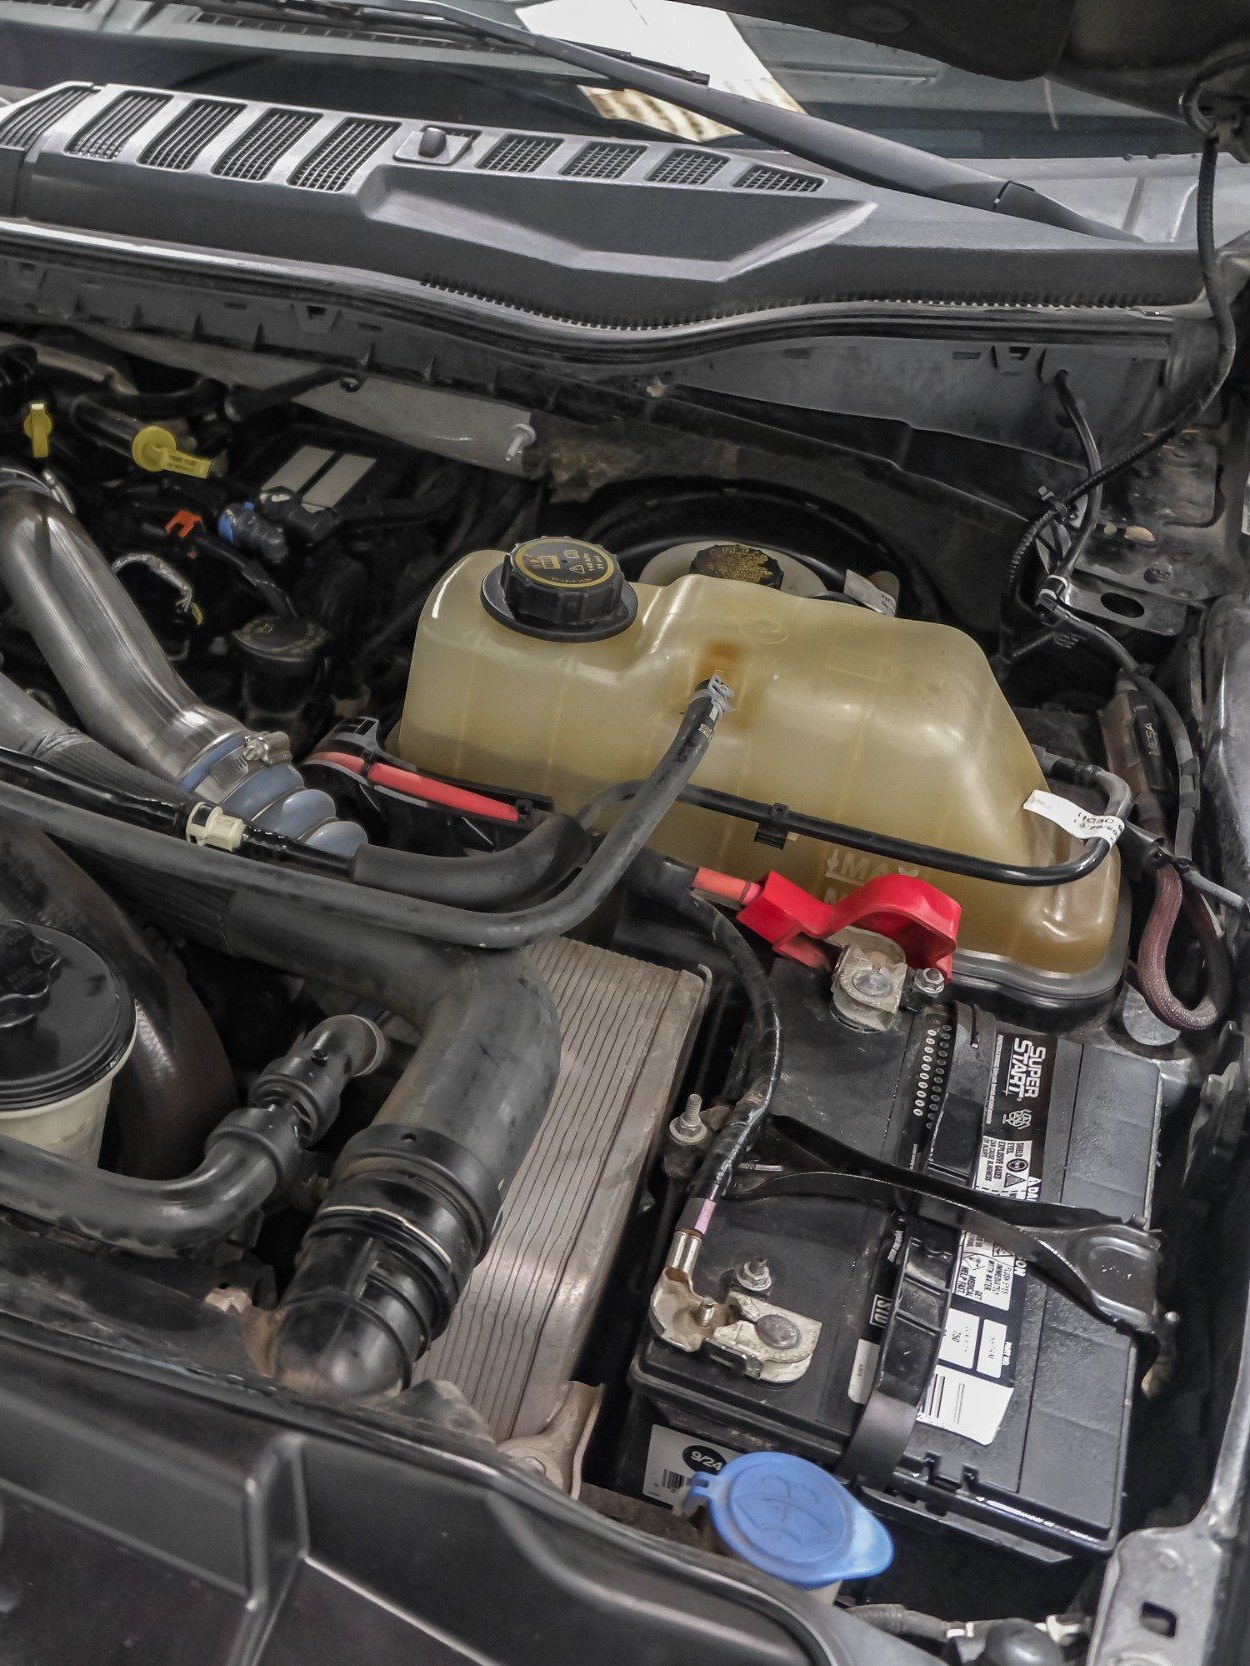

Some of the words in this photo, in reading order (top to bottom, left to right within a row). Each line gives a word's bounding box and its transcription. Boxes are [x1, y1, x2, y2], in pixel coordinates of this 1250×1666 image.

[1024, 1046, 1047, 1098] SUPER
[987, 1148, 996, 1160] CAUSE
[995, 1141, 1006, 1164] EXPLOSIVE
[1015, 1142, 1025, 1157] SHIELD
[985, 1160, 994, 1182] BLINDNESS
[994, 1165, 1004, 1180] GASES
[959, 1266, 969, 1281] HELP
[986, 1259, 995, 1274] WITH
[965, 1275, 977, 1298] MEDICAL
[992, 1263, 1002, 1295] IMMEDIATELY
[974, 1290, 983, 1300] GET
[690, 1450, 723, 1471] 9/24
